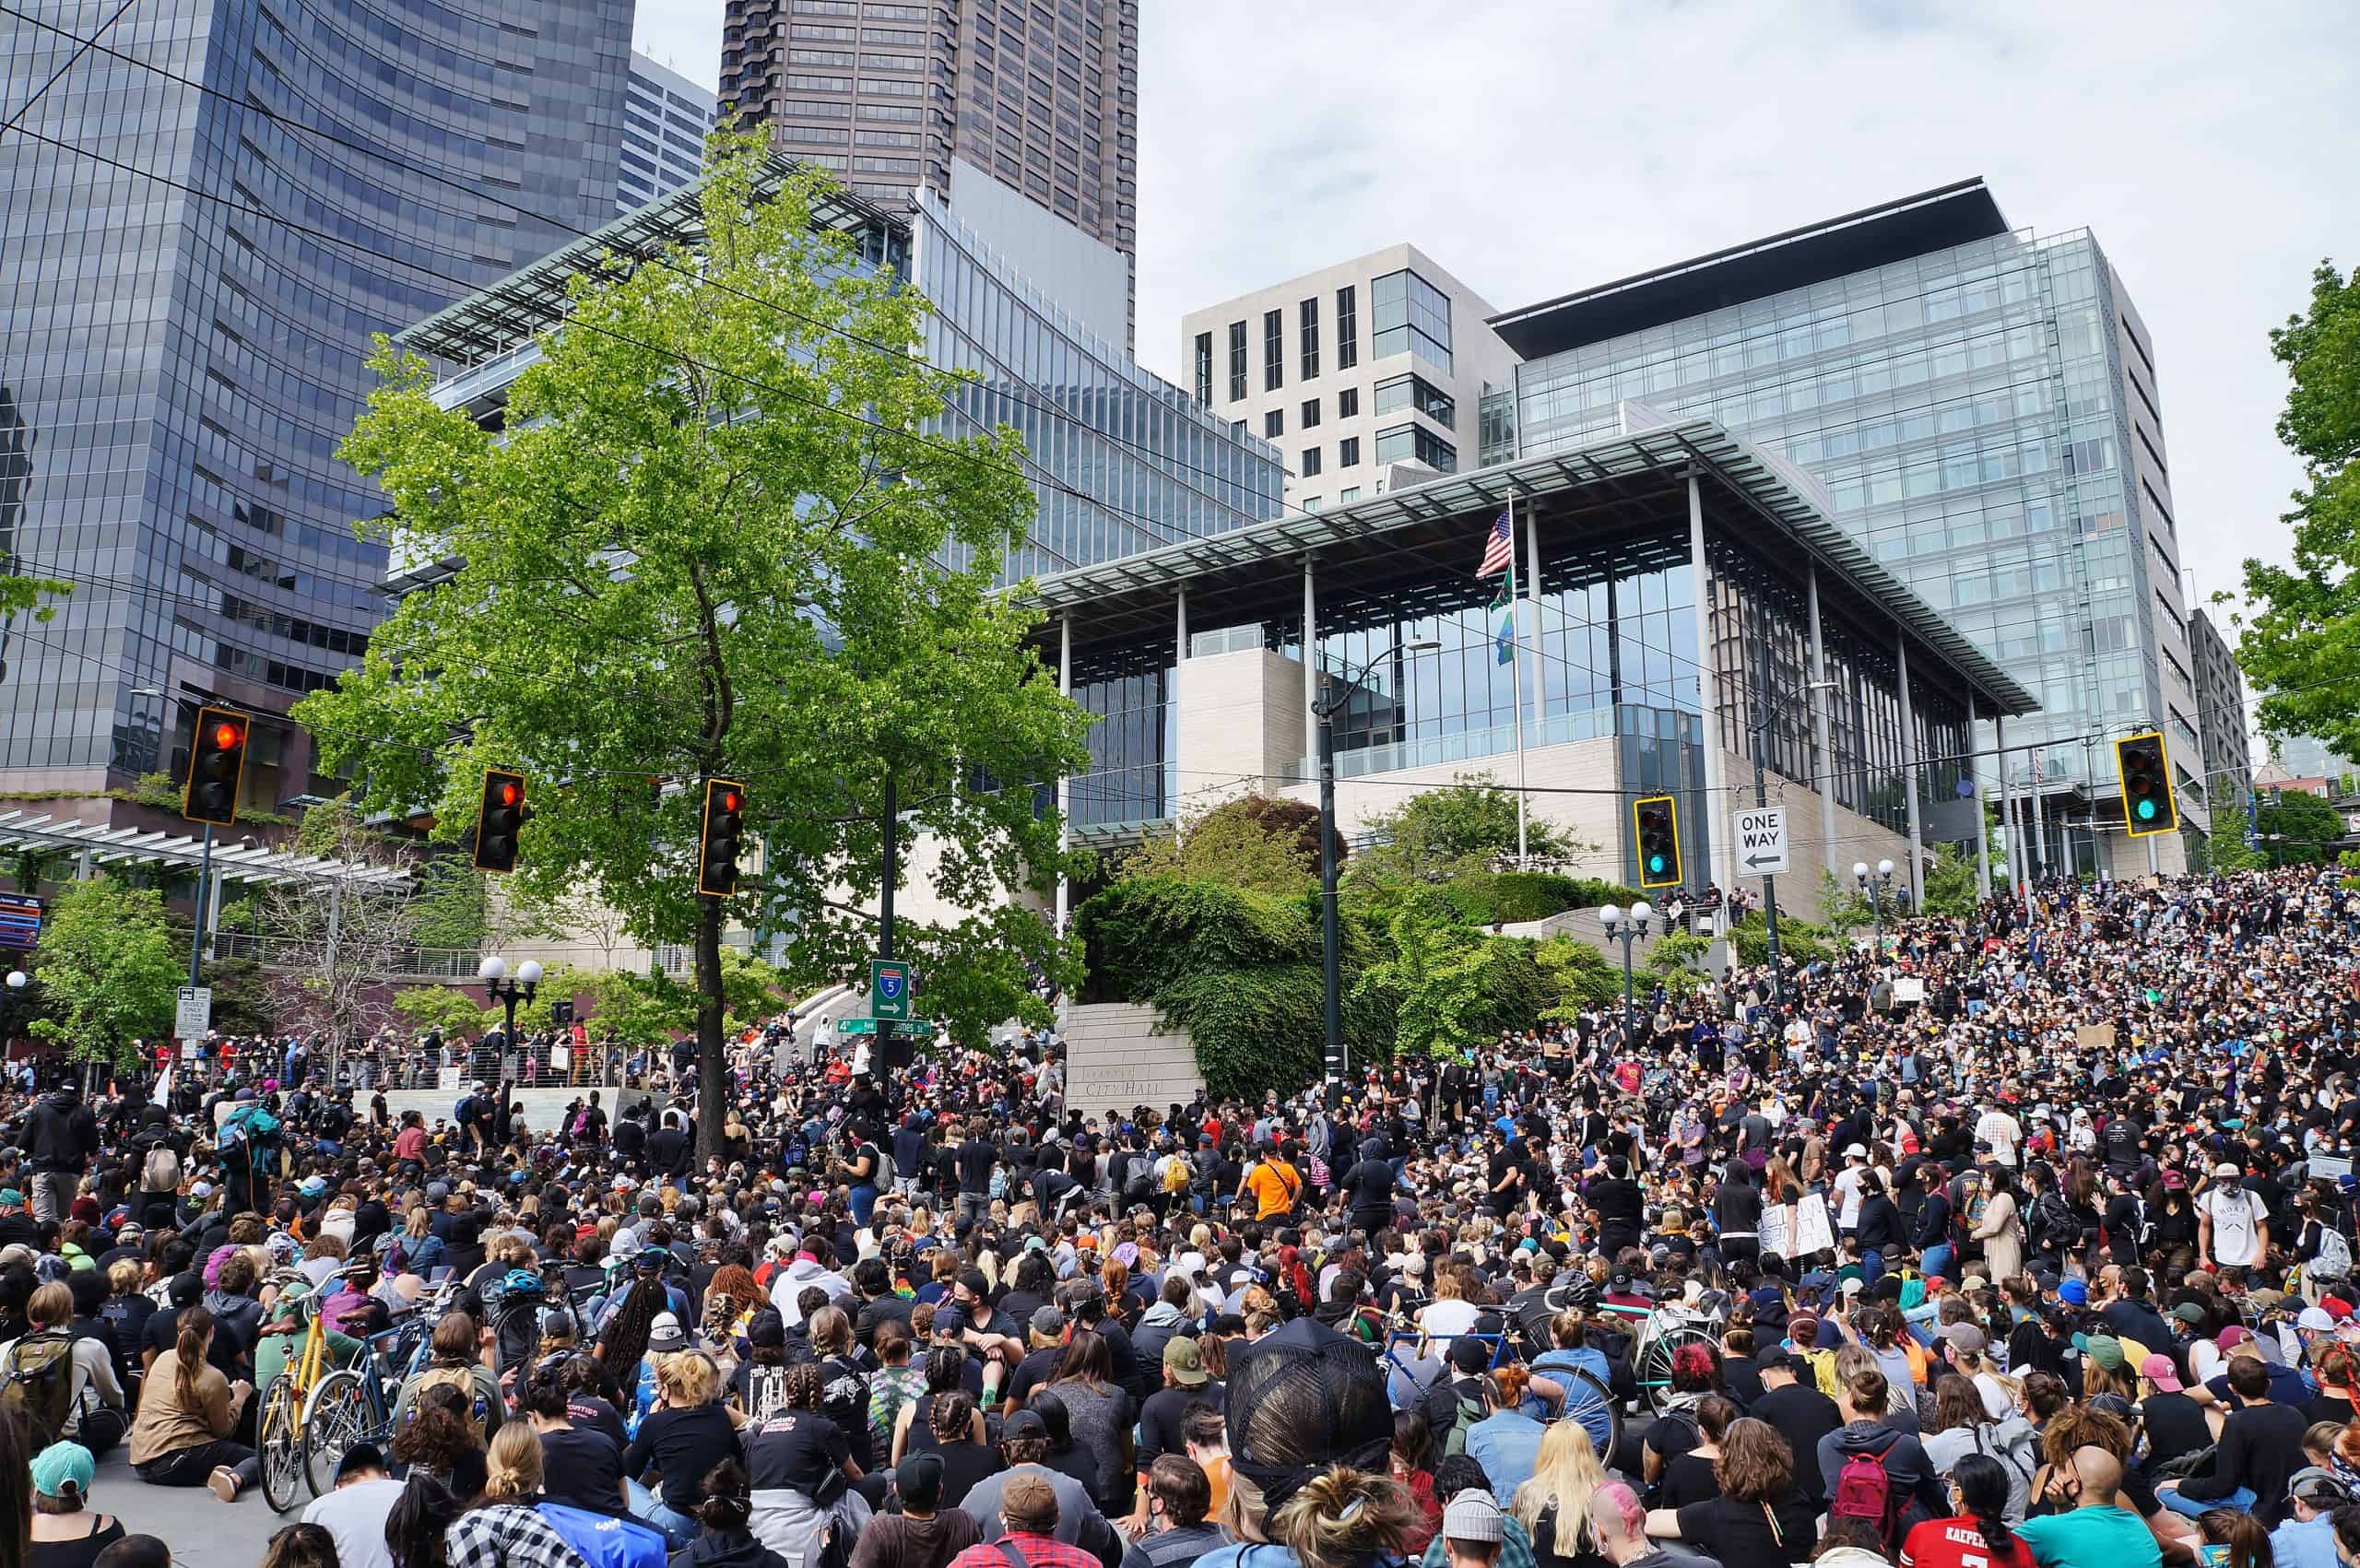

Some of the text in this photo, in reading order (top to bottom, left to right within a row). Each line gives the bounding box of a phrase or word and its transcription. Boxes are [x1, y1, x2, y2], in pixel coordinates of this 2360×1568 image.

[1742, 814, 1778, 831] ONE
[1743, 831, 1779, 848] WAY
[888, 981, 895, 993] 5
